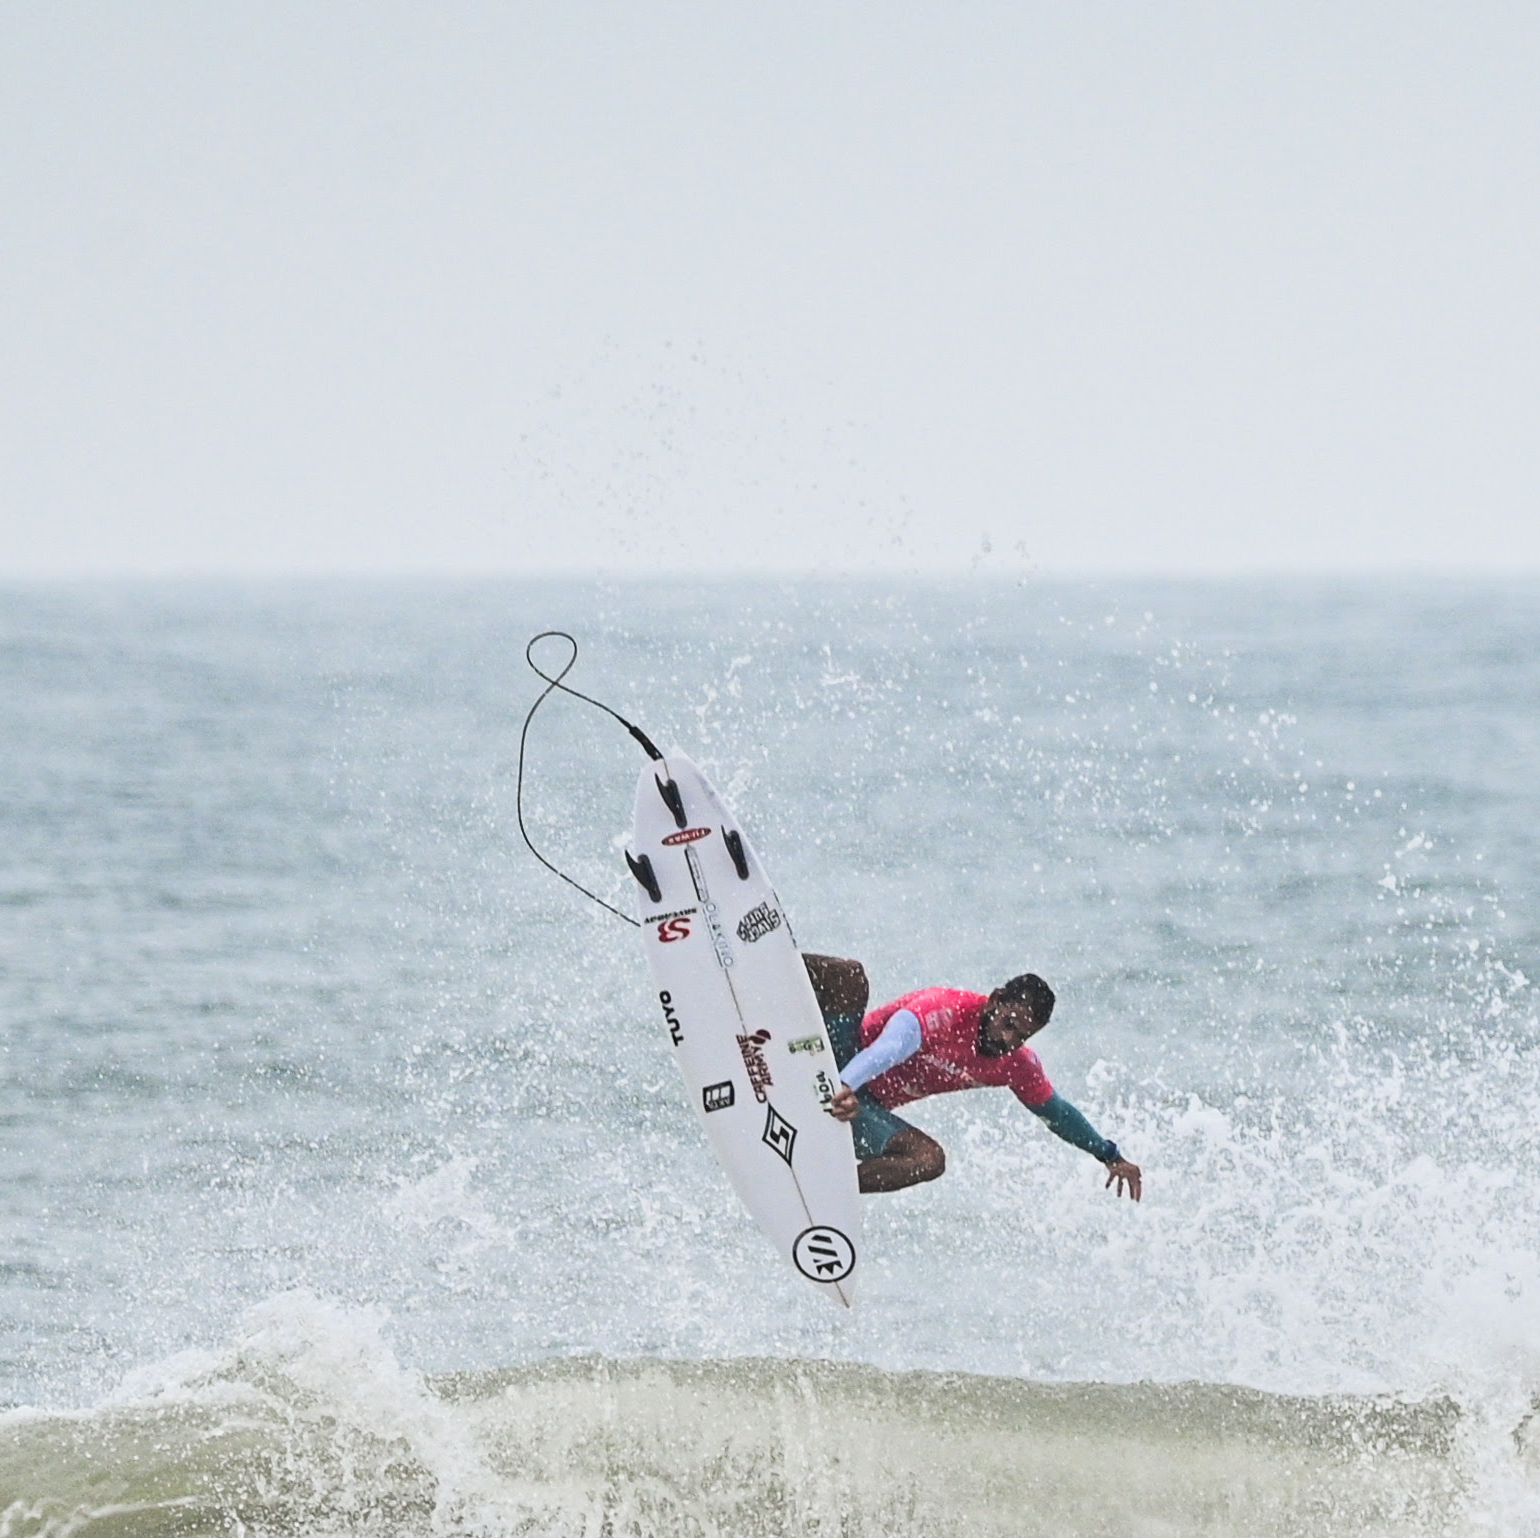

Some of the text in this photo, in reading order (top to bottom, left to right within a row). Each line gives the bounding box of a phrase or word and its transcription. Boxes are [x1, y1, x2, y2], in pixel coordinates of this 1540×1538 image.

[659, 990, 684, 1047] TUYO
[736, 1034, 768, 1103] CAFFEINE
[752, 1045, 774, 1087] ARMY
